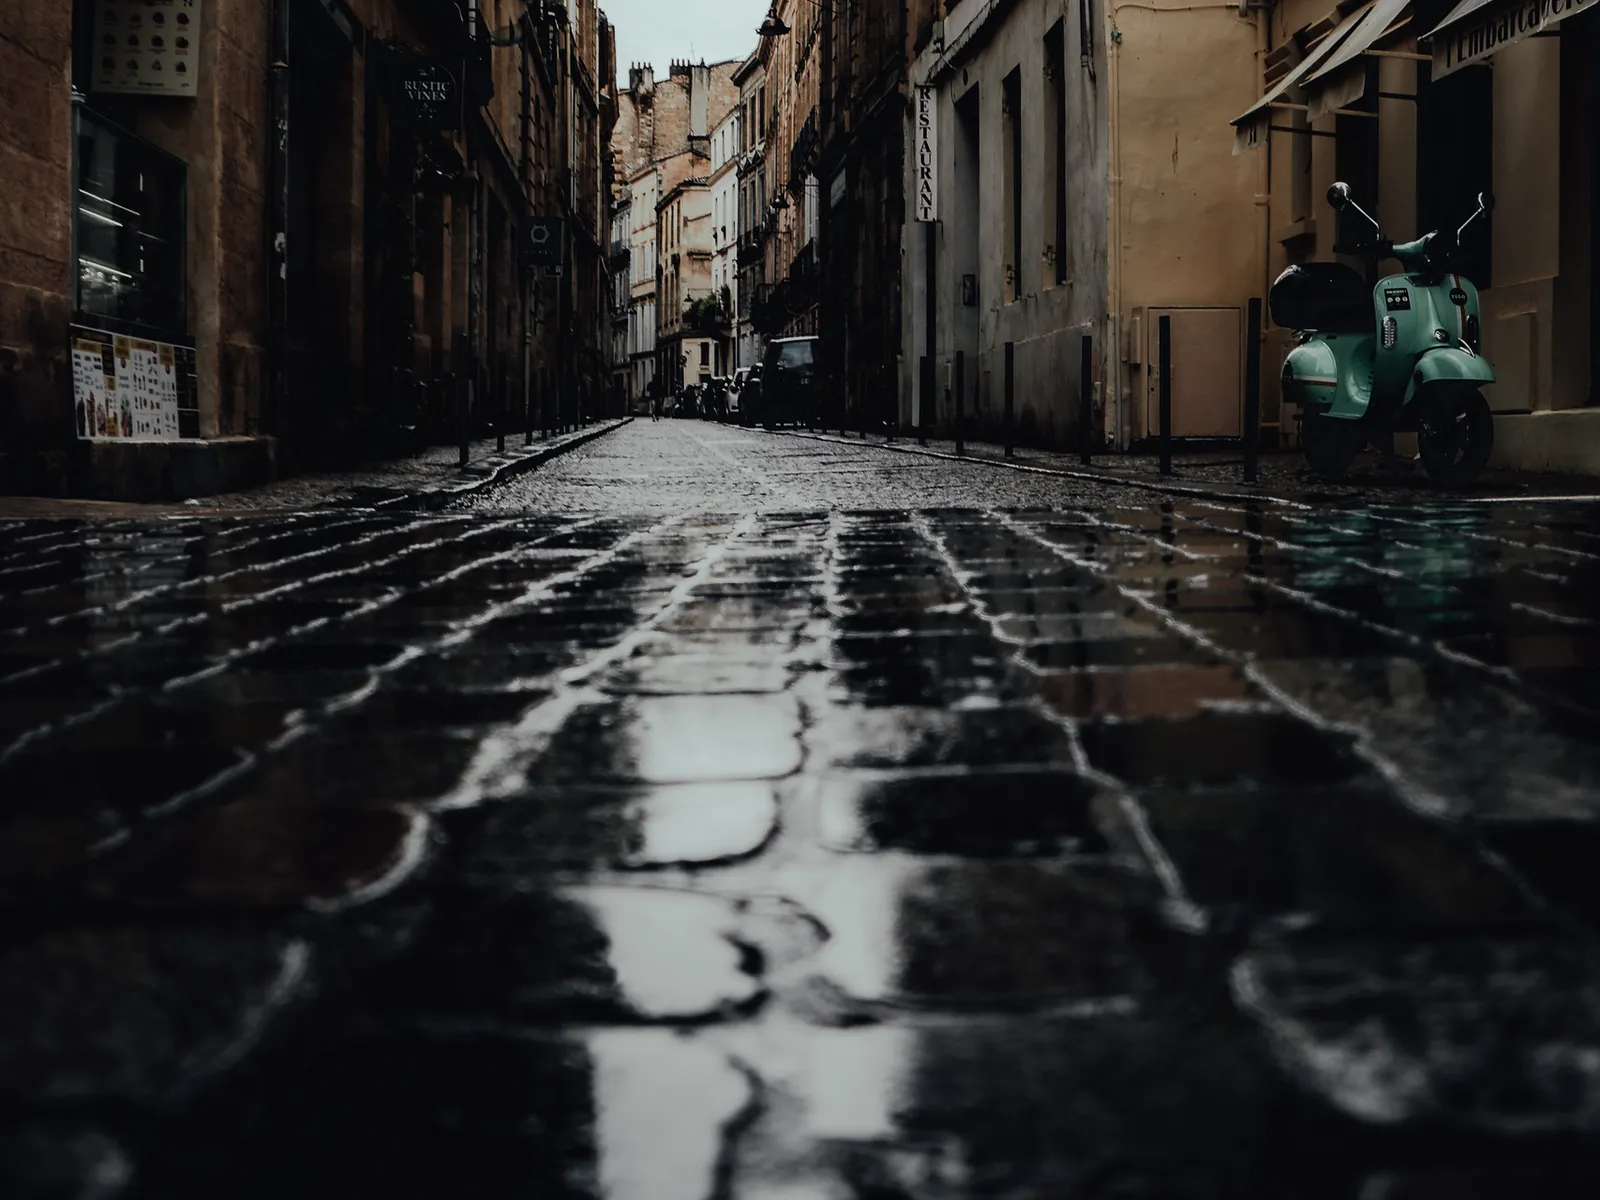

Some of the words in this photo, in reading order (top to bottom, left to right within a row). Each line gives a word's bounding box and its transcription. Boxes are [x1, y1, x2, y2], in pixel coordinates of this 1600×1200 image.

[404, 80, 450, 92] RUSTIC
[407, 90, 447, 101] VINES
[919, 86, 932, 220] RESTAURANT
